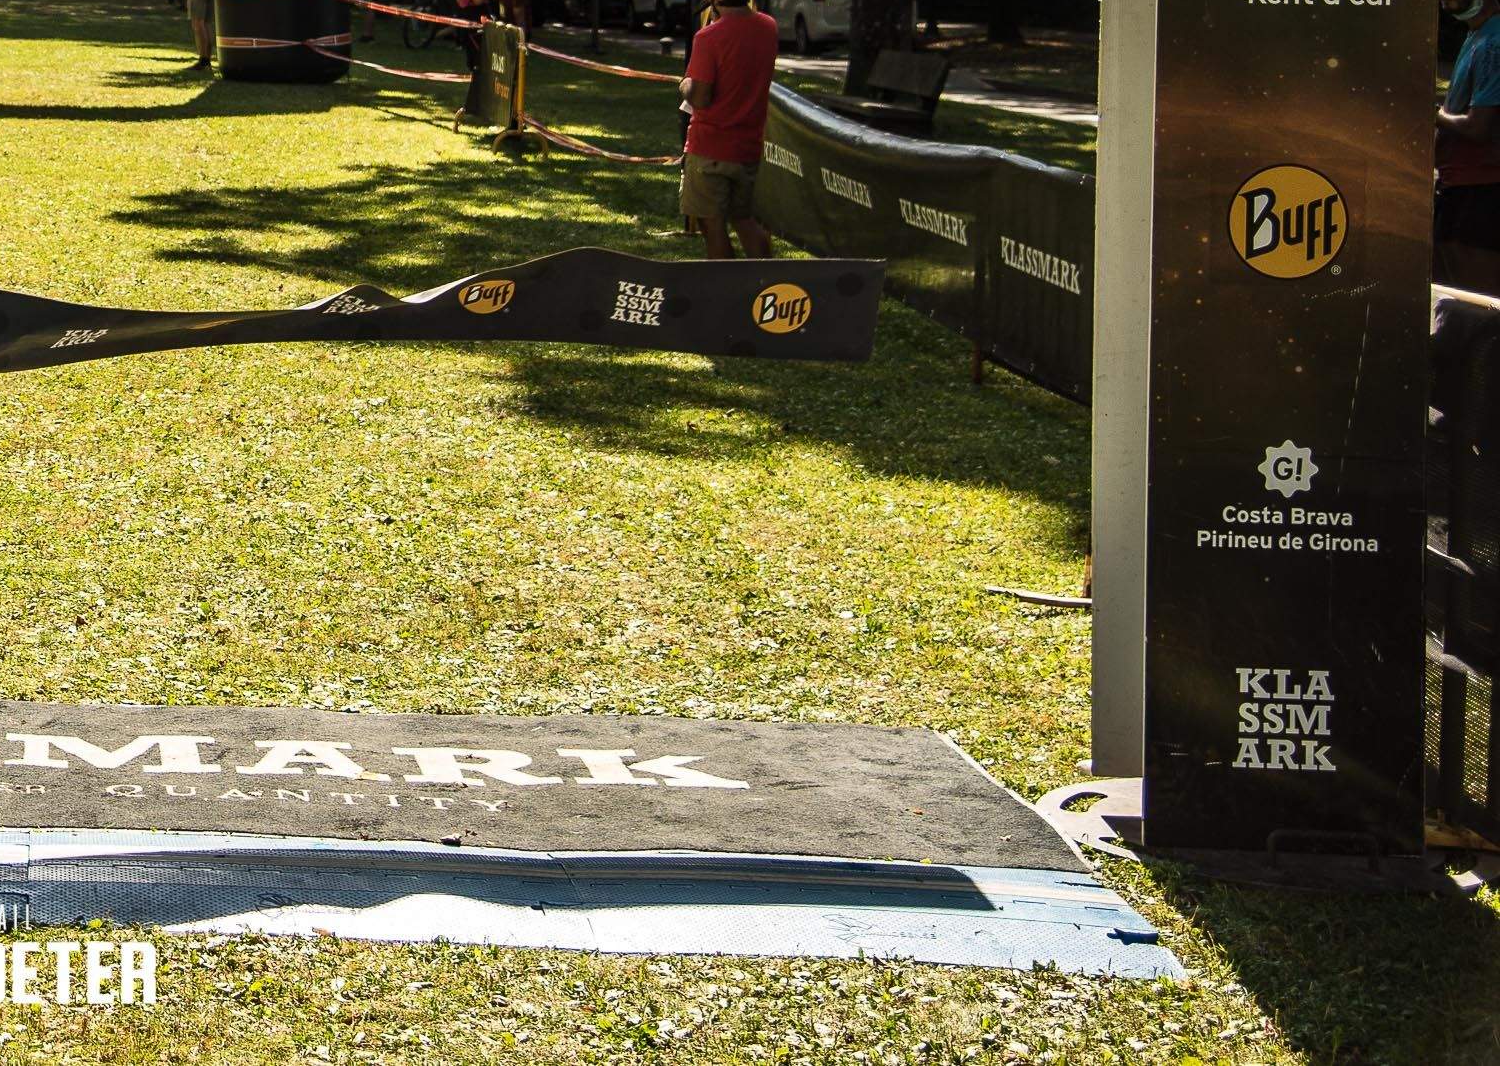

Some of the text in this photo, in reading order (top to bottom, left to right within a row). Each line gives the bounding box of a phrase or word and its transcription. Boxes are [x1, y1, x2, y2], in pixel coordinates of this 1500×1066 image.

[898, 197, 968, 247] KLASSMARK
[1000, 235, 1081, 296] KLASSMARK
[615, 294, 662, 313] SSM
[618, 280, 666, 301] KLA
[610, 307, 661, 326] ARK
[1221, 505, 1354, 527] Costa Brava
[1196, 529, 1379, 553] Pirineu de Girona
[1235, 667, 1335, 701] KLA
[1238, 702, 1332, 736] SSM
[1232, 737, 1337, 772] ARK
[104, 782, 511, 814] QUANTITY
